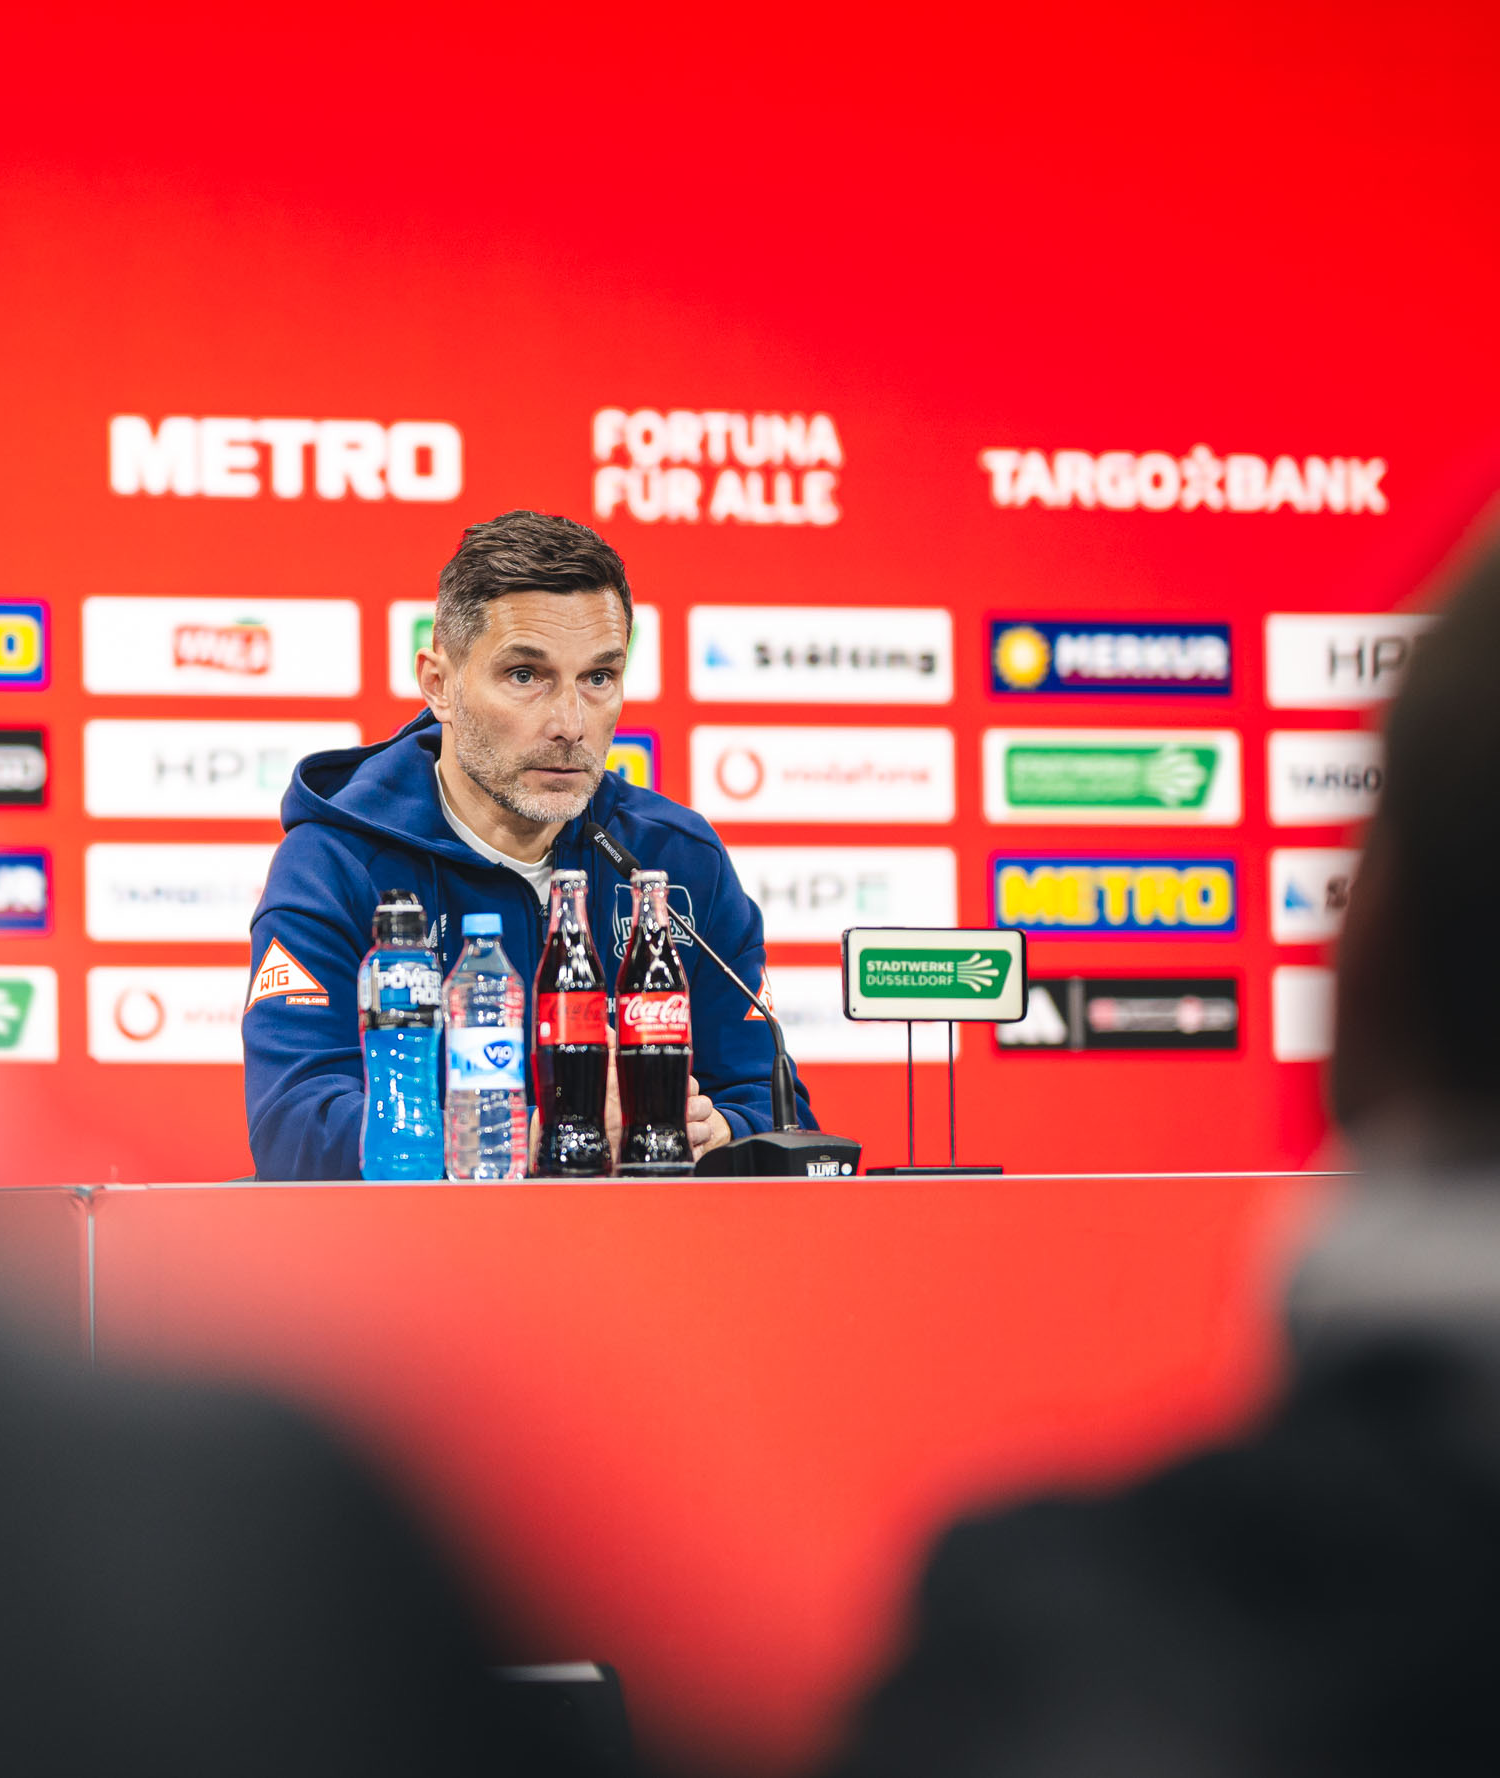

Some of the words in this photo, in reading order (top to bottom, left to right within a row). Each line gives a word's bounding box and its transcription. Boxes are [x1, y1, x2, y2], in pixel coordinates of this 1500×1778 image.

[593, 408, 843, 467] FORTUNA
[109, 414, 463, 501] METRO
[594, 465, 701, 522] FÜR
[709, 468, 841, 525] ALLE
[1055, 633, 1231, 681] MERKUR
[1328, 636, 1408, 684] HP
[154, 749, 291, 788] HPE
[1293, 766, 1384, 792] TARGO
[759, 873, 890, 910] HPE
[1001, 866, 1231, 926] METRO
[260, 963, 290, 992] WTG
[866, 960, 954, 973] STADTWERKE
[866, 973, 954, 986] DÜSSELDORF
[297, 997, 327, 1005] wtg.com
